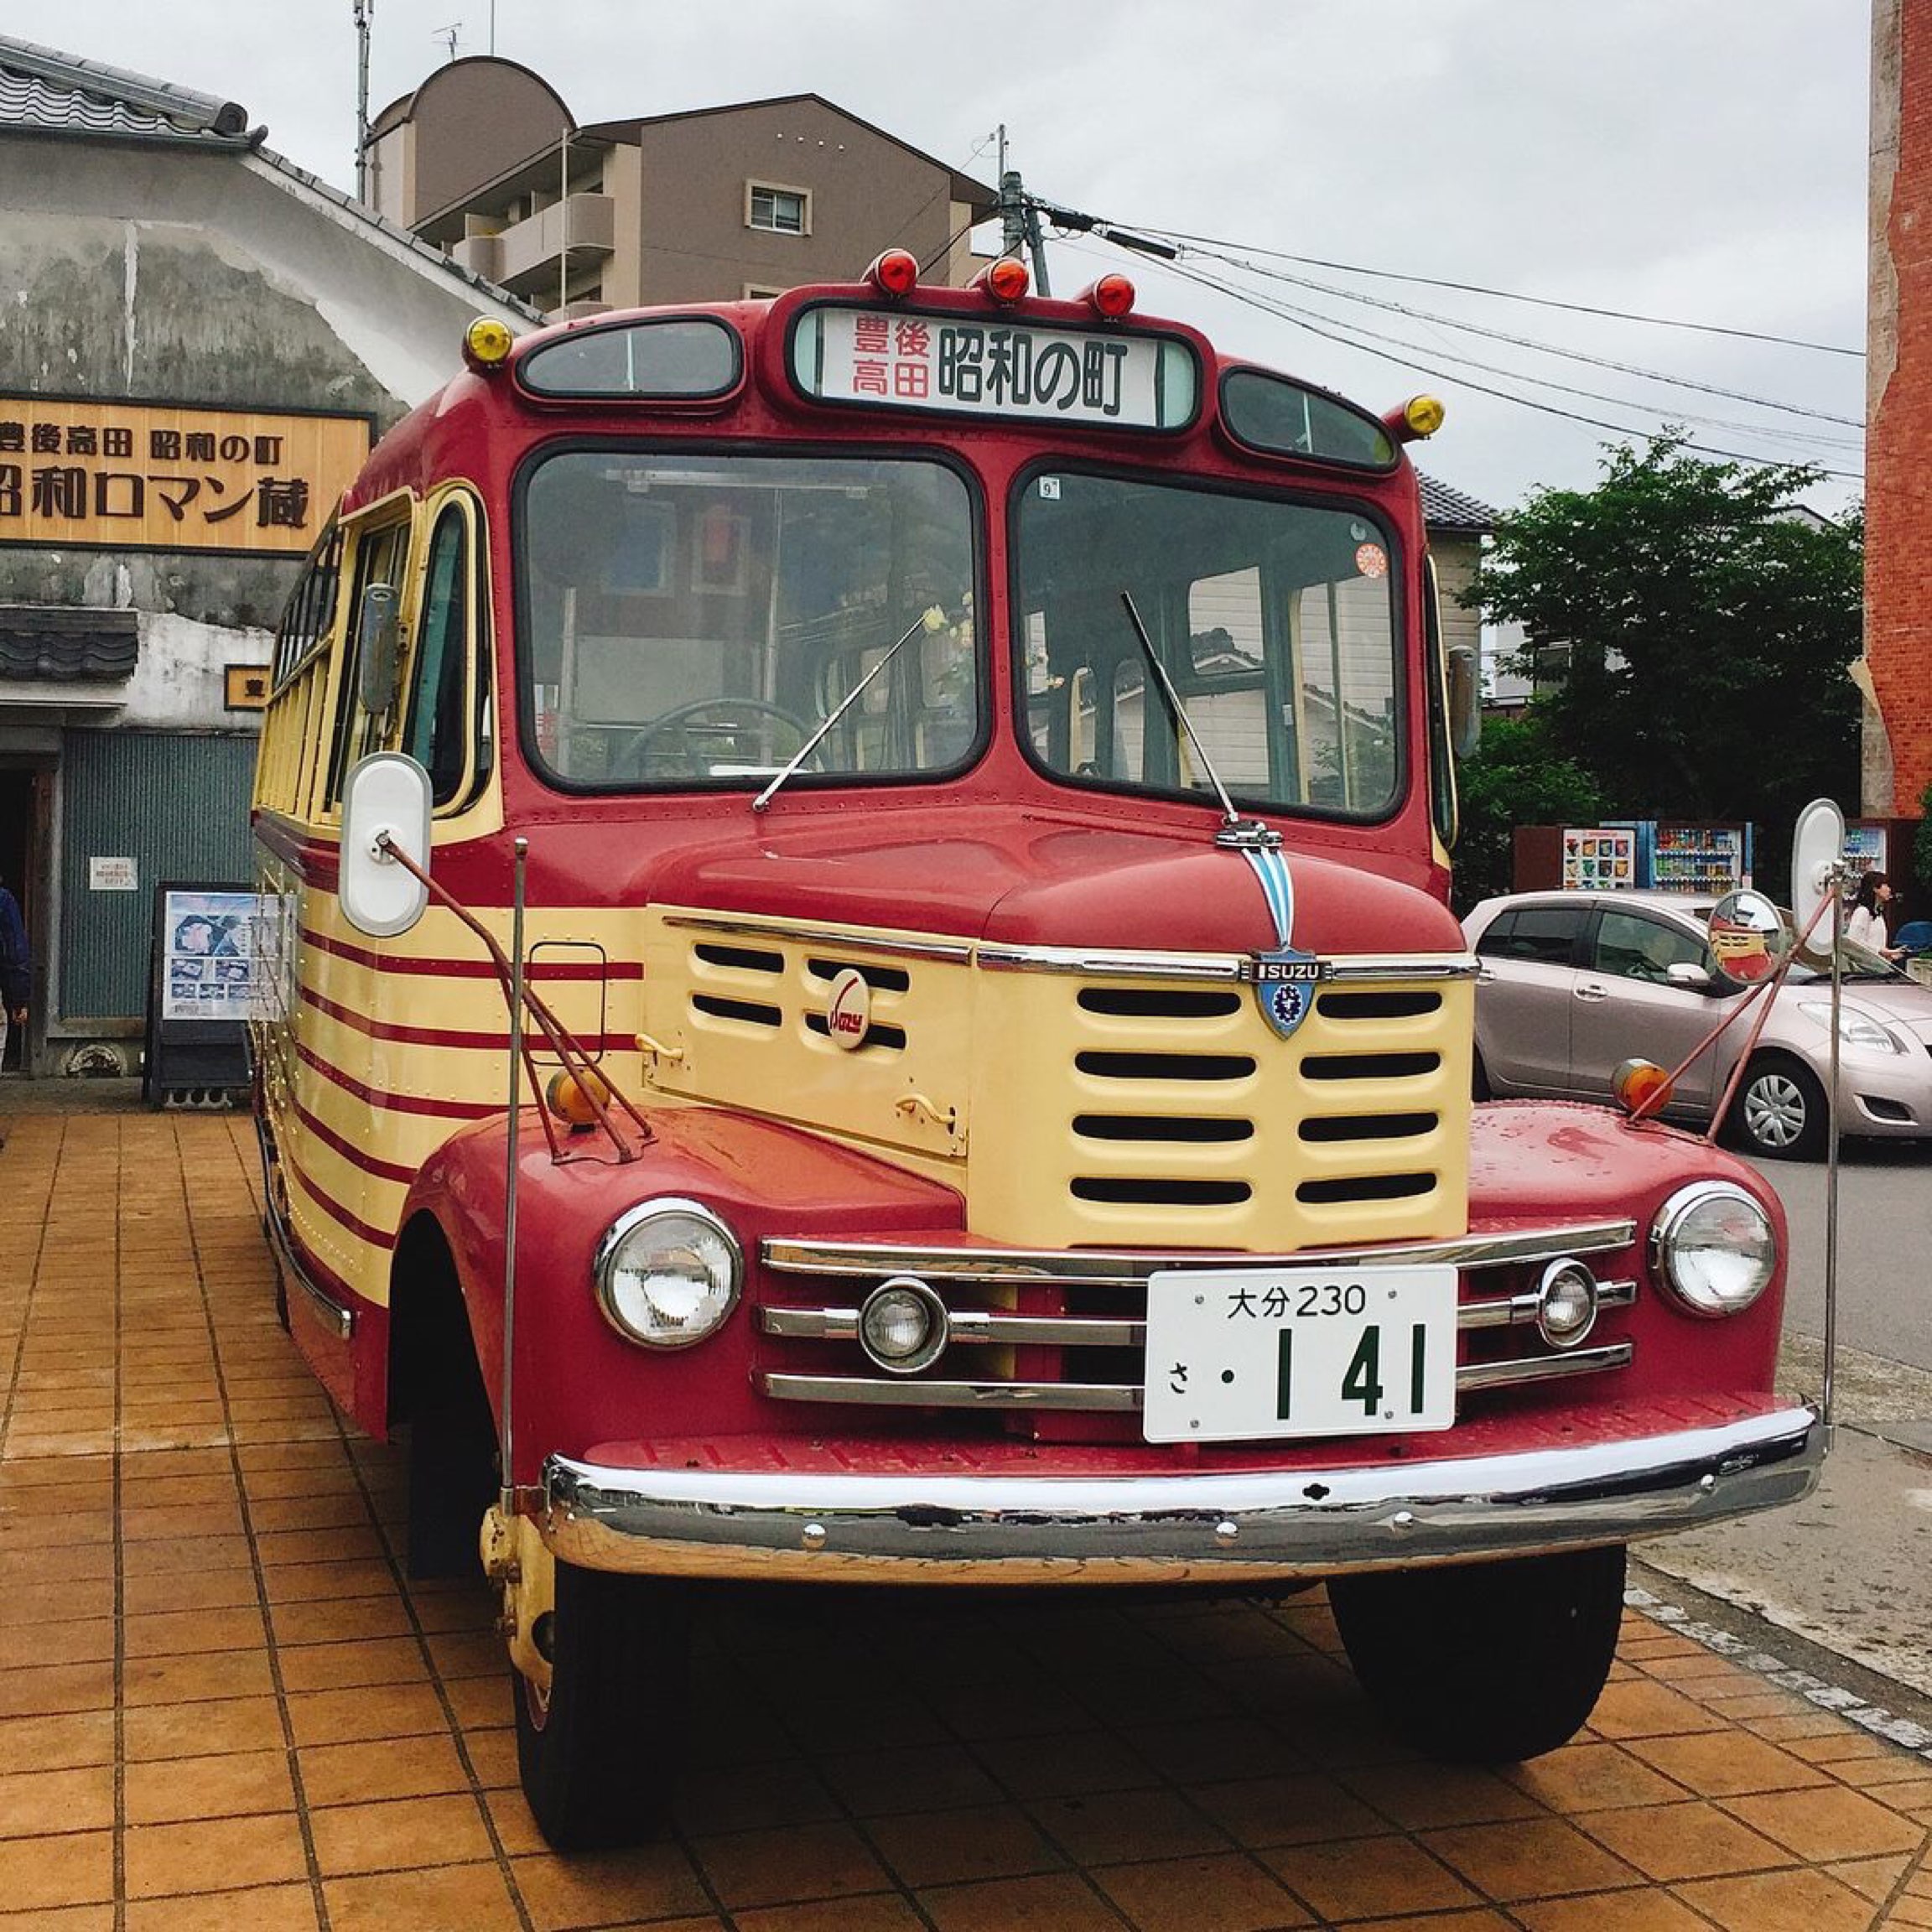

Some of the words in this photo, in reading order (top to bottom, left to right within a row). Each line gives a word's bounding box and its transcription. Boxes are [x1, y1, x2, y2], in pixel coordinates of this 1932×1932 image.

[853, 315, 930, 358] 豊後
[852, 358, 929, 398] 高田
[938, 327, 1128, 416] 昭和の町
[0, 422, 132, 458] 豊後高田
[150, 429, 283, 465] 昭和の町
[1259, 963, 1319, 979] ISUZU
[1227, 1285, 1366, 1319] 大分230
[1170, 1362, 1188, 1394] さ
